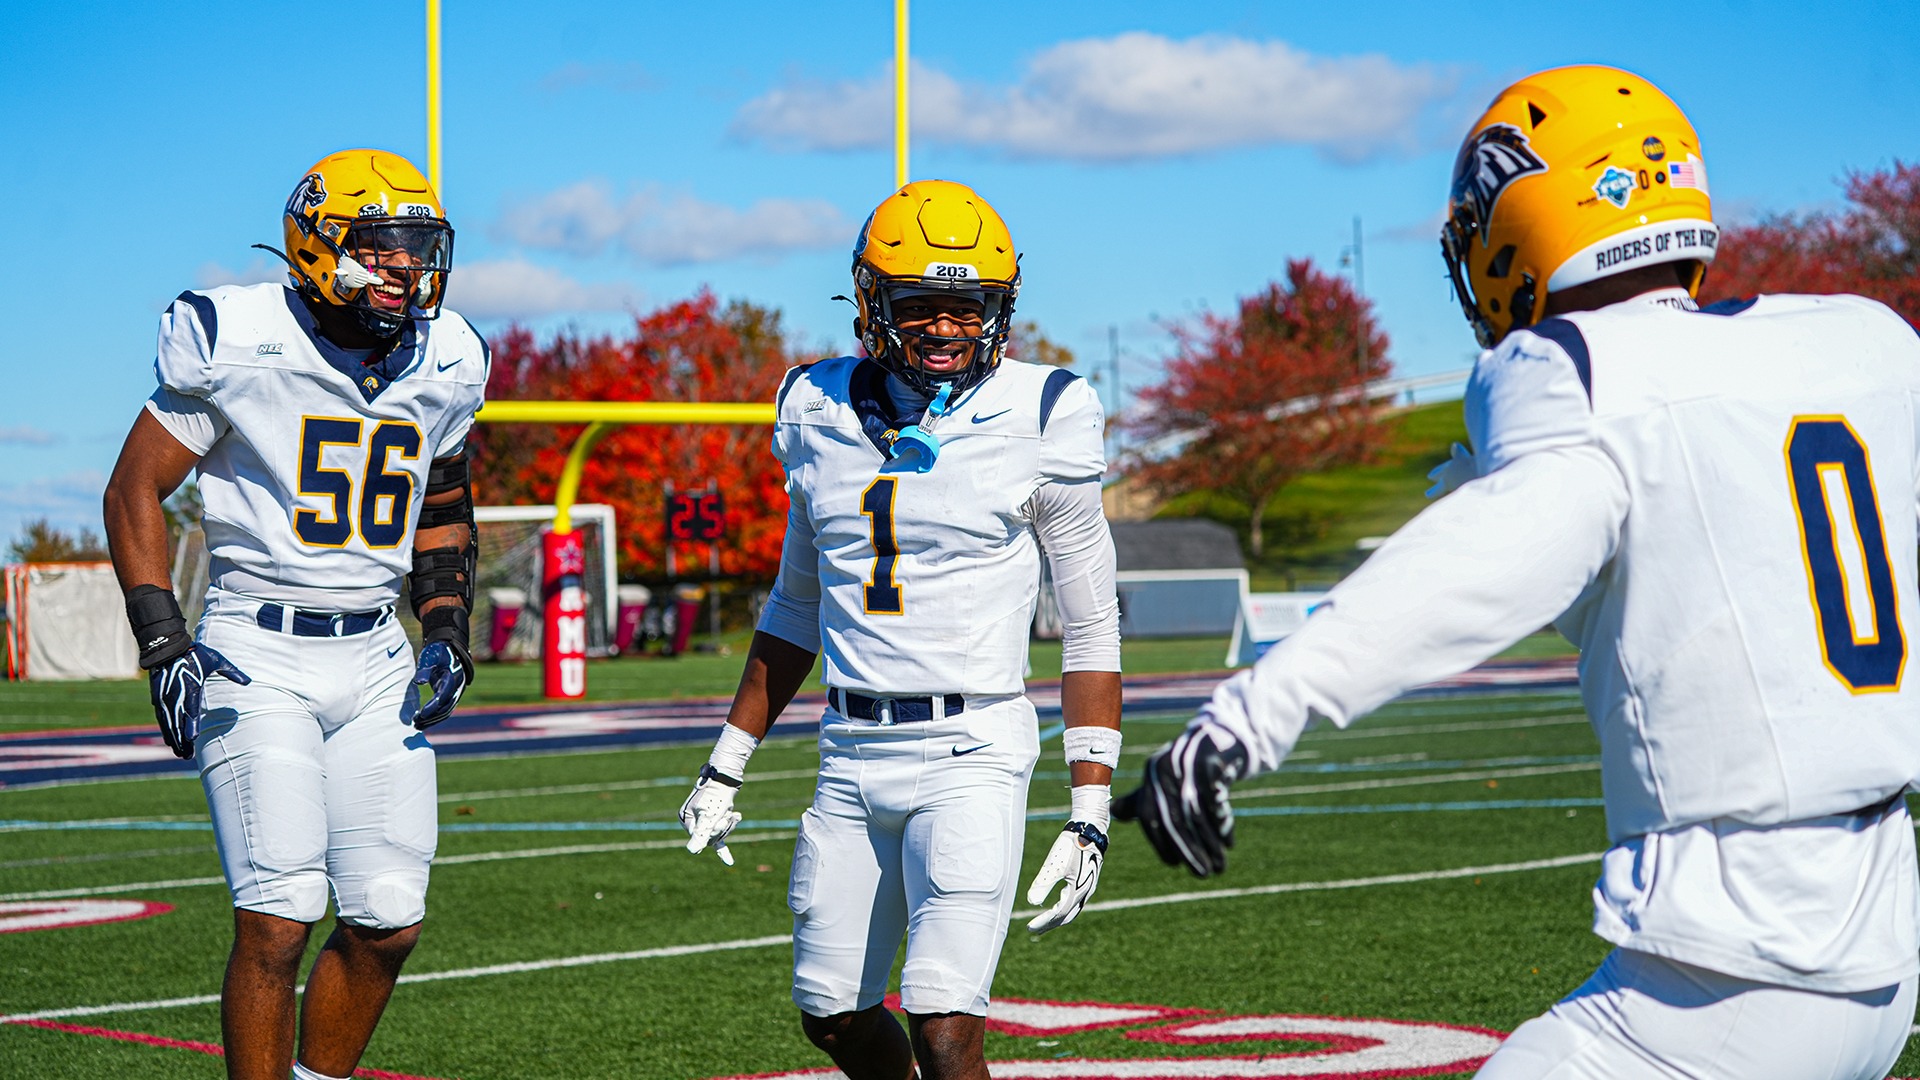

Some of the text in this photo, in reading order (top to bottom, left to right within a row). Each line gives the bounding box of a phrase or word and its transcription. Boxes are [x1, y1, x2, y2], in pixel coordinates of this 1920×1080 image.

[407, 205, 431, 217] 203
[936, 265, 968, 278] 203
[1596, 237, 1651, 271] RIDERS
[1655, 232, 1671, 253] OF
[1675, 229, 1697, 249] THE
[293, 414, 424, 549] 56
[671, 494, 724, 539] 25
[860, 475, 904, 615] 1
[1783, 414, 1908, 695] 0
